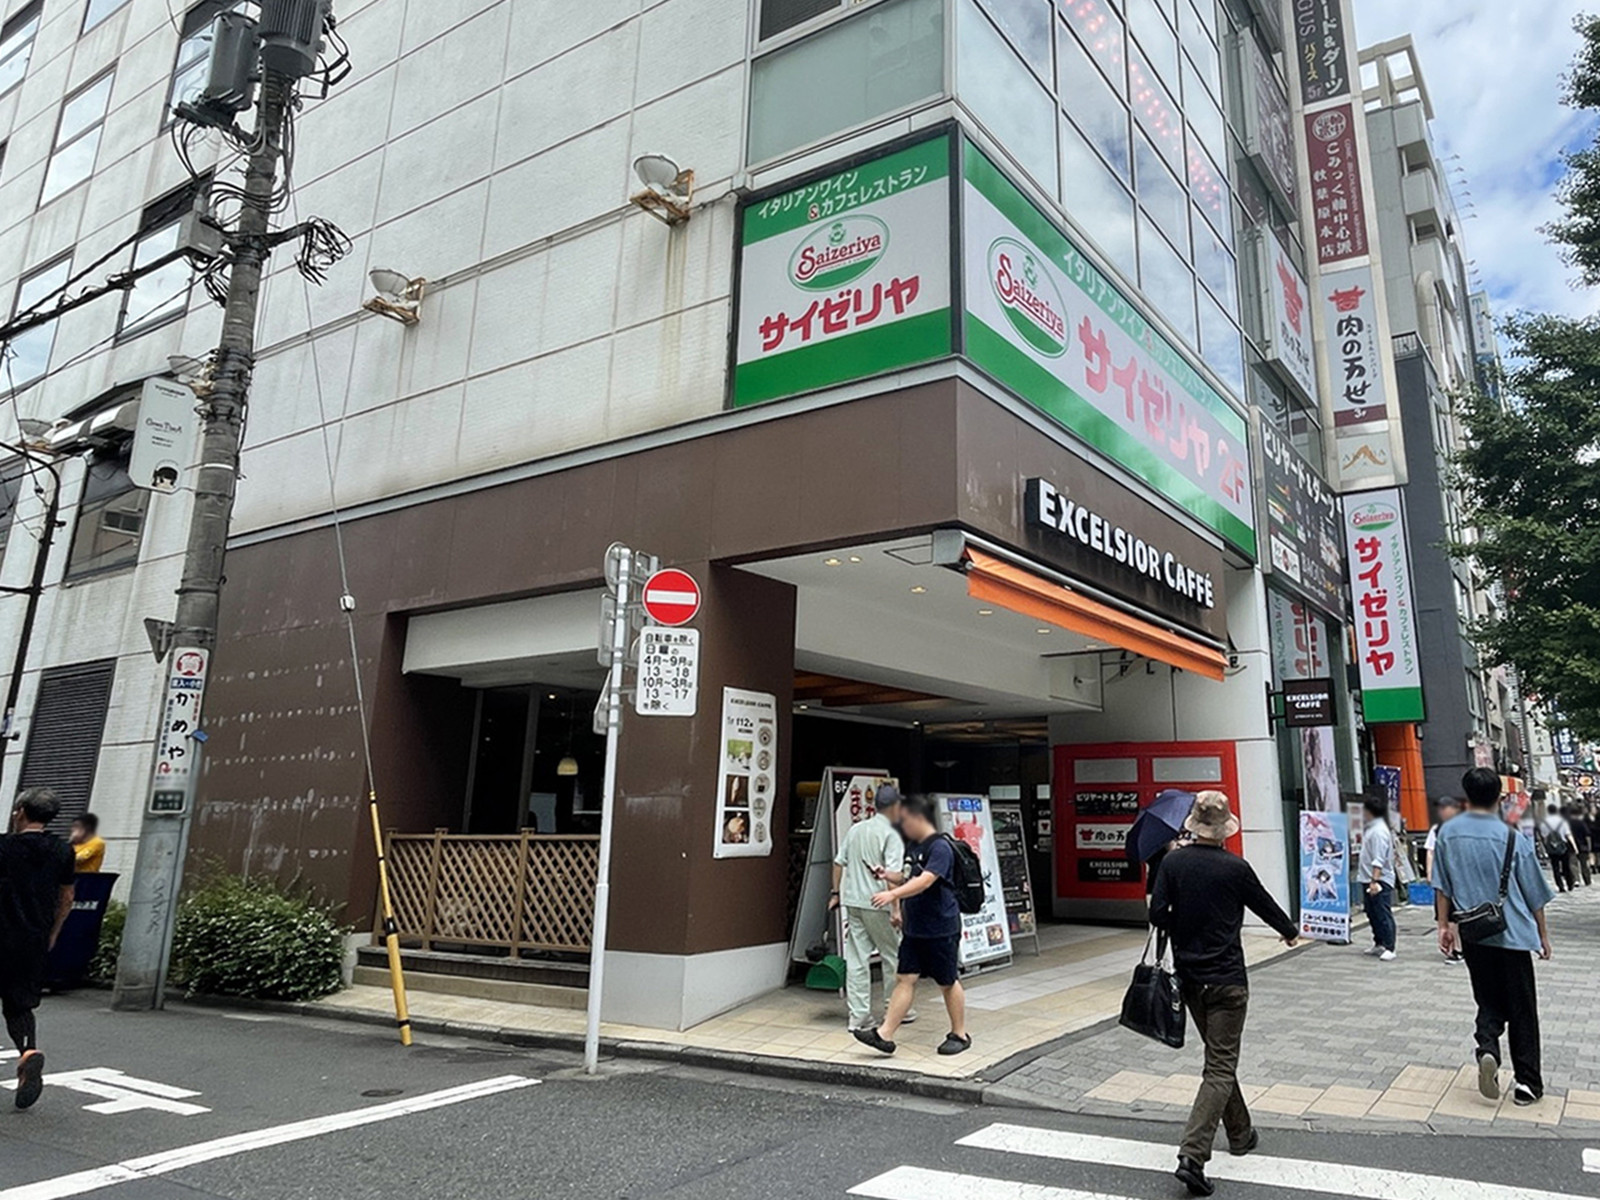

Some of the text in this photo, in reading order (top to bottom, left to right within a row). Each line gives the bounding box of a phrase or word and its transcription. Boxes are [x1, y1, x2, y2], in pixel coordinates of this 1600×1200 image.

[1321, 0, 1343, 95] ード&ダーツ
[758, 171, 859, 218] イタリアンワイン
[795, 234, 882, 281] Saizeriya
[996, 253, 1065, 341] Saizeriya
[759, 274, 920, 352] サイゼリヤ
[1336, 314, 1372, 405] 肉の万世
[1078, 314, 1245, 505] サイゼリヤ 2F
[1039, 478, 1162, 582] EXCELSIOR
[1354, 536, 1395, 677] サイゼリヤ
[168, 692, 195, 760] かめや
[834, 780, 848, 794] 6F
[1095, 829, 1125, 841] 肉の万
